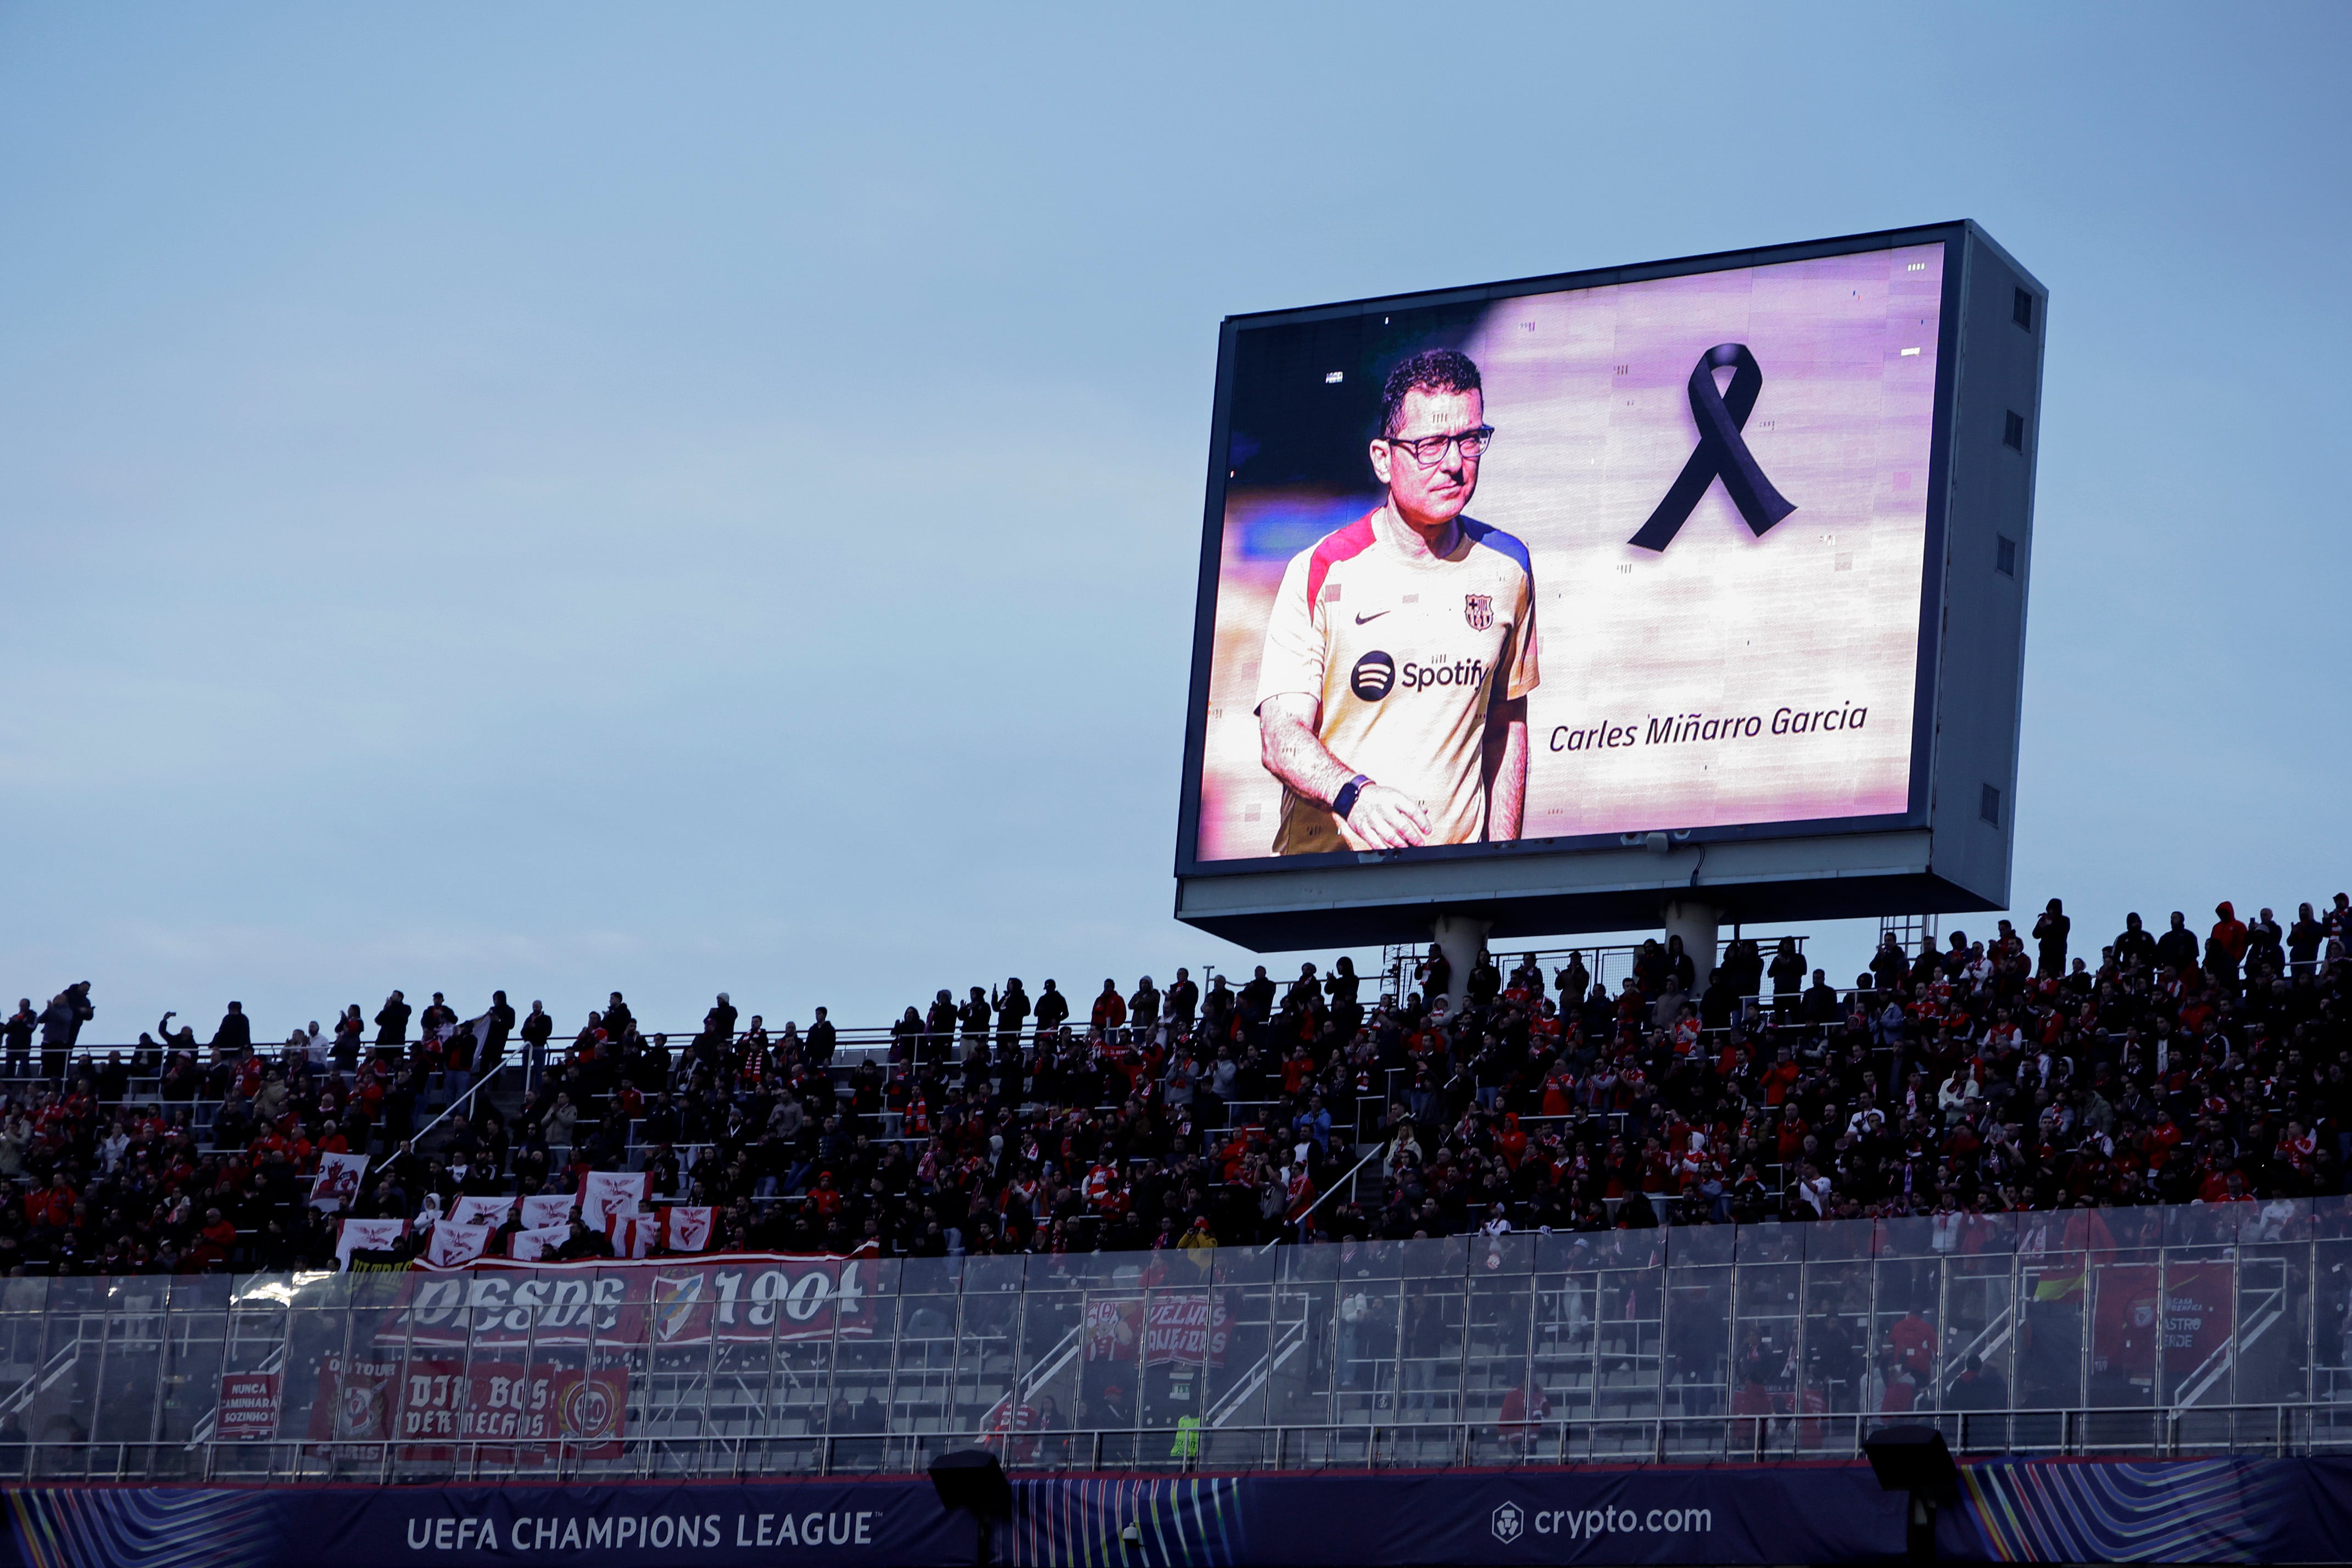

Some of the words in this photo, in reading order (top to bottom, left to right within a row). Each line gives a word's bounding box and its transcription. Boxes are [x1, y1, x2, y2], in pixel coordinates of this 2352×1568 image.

[1402, 659, 1489, 692] Spotify
[1550, 719, 1637, 752] Carles
[1645, 713, 1761, 745] Miñarro
[1771, 700, 1869, 735] Garcia
[397, 1277, 625, 1331] DESDE
[715, 1261, 862, 1325] 1904
[222, 1395, 277, 1409] AMINHARÁ
[232, 1383, 267, 1394] NUNCA
[224, 1411, 269, 1423] SOZINHO
[408, 1518, 498, 1550] UEFA
[511, 1515, 722, 1550] CHAMPIONS
[736, 1511, 872, 1547] LEAGUE
[1535, 1504, 1712, 1539] crypto.com
